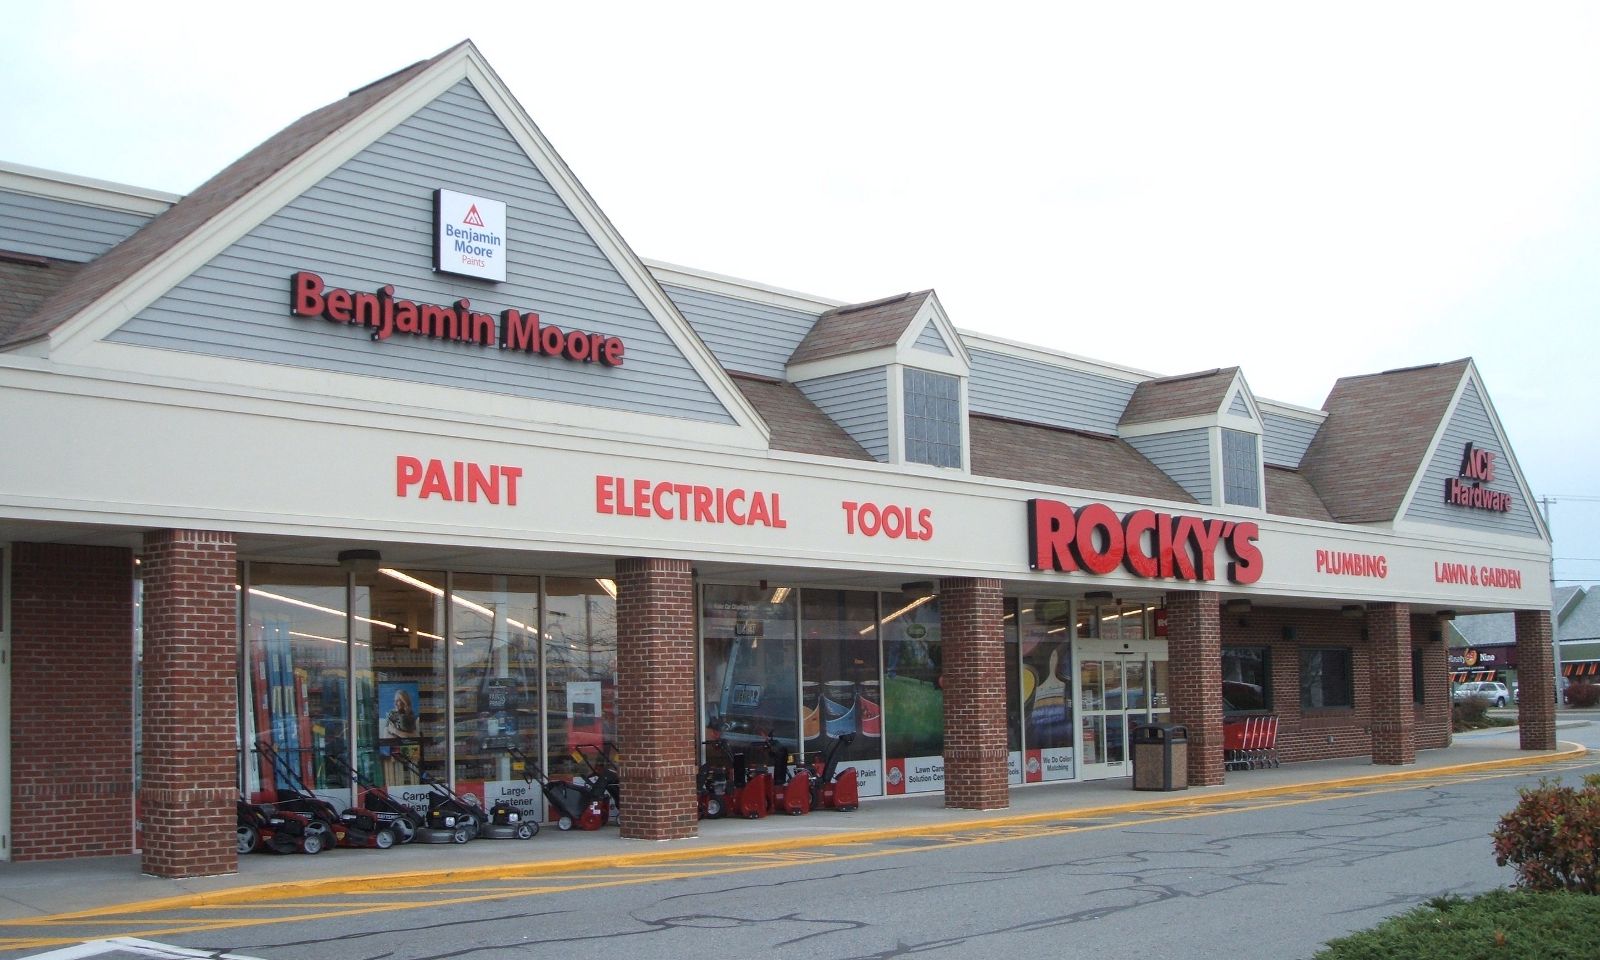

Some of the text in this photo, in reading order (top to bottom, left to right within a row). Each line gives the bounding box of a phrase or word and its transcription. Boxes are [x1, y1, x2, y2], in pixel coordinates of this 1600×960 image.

[446, 224, 501, 246] Benjamin
[454, 240, 493, 258] Moore
[462, 254, 485, 268] Paints
[291, 271, 625, 367] Benjamin Moore
[1459, 442, 1495, 481] ACE
[396, 455, 523, 506] PAINT
[596, 475, 787, 529] ELECTRICAL
[1445, 478, 1512, 512] Hardware
[842, 501, 933, 541] TOOLS
[1028, 498, 1264, 585] ROCKY'S
[1316, 549, 1388, 578] PLUMBING
[1434, 561, 1521, 589] LAWN & GARDEN
[860, 769, 877, 777] Paint
[908, 774, 932, 783] Solution
[915, 766, 931, 774] Lawn
[402, 792, 431, 801] Carpe
[501, 787, 526, 796] Large
